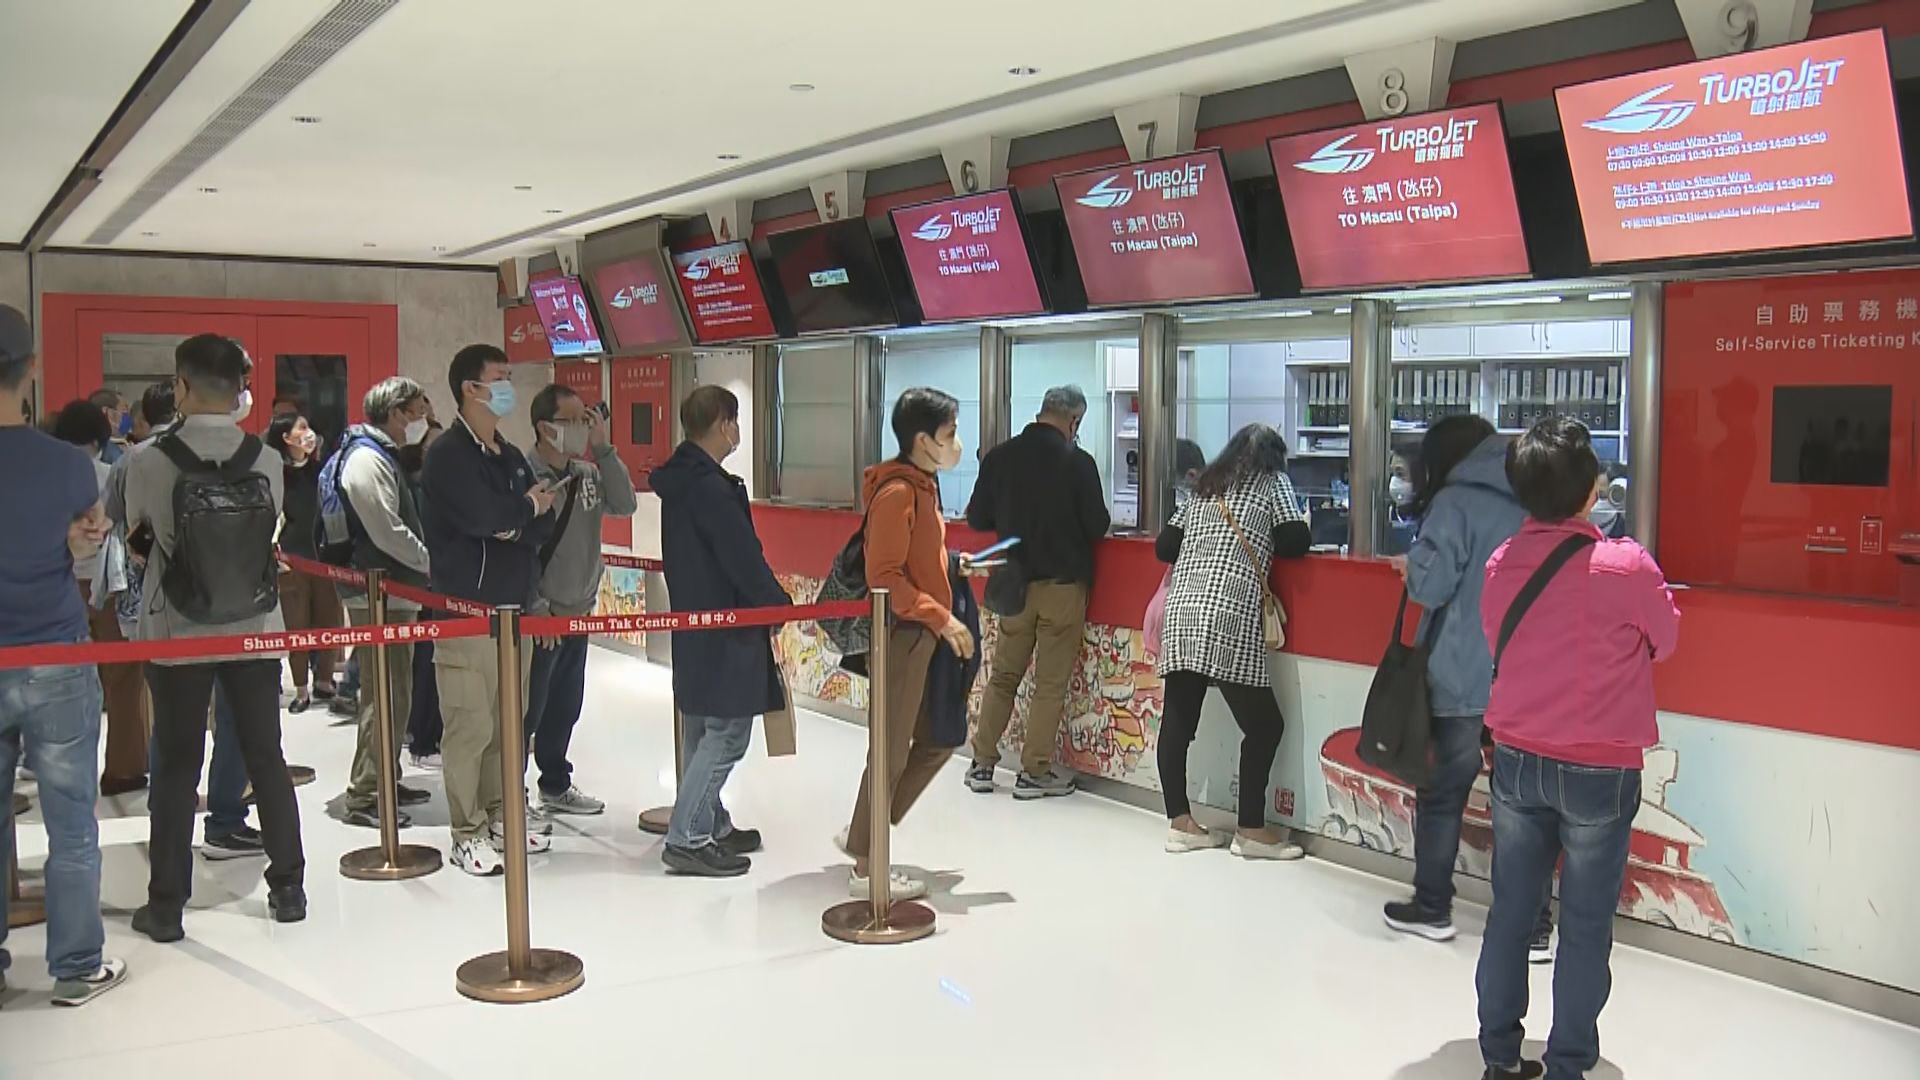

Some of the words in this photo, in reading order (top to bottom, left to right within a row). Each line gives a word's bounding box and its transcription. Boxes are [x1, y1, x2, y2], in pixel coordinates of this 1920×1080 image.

[1718, 0, 1759, 51] 9
[1379, 68, 1409, 115] 8
[1137, 121, 1158, 159] 7
[960, 159, 979, 193] 6
[824, 190, 840, 219] 5
[1360, 210, 1403, 225] Macau
[1127, 239, 1158, 252] Macau
[1756, 298, 1918, 325] 自助票務機
[1715, 335, 1816, 352] Self-Service
[1821, 331, 1905, 350] Ticketing
[569, 618, 604, 633] Shun
[607, 617, 632, 631] Tak
[635, 615, 679, 630] Centre
[243, 636, 285, 651] Shun
[288, 633, 317, 648] Tak
[321, 629, 372, 645] Centre
